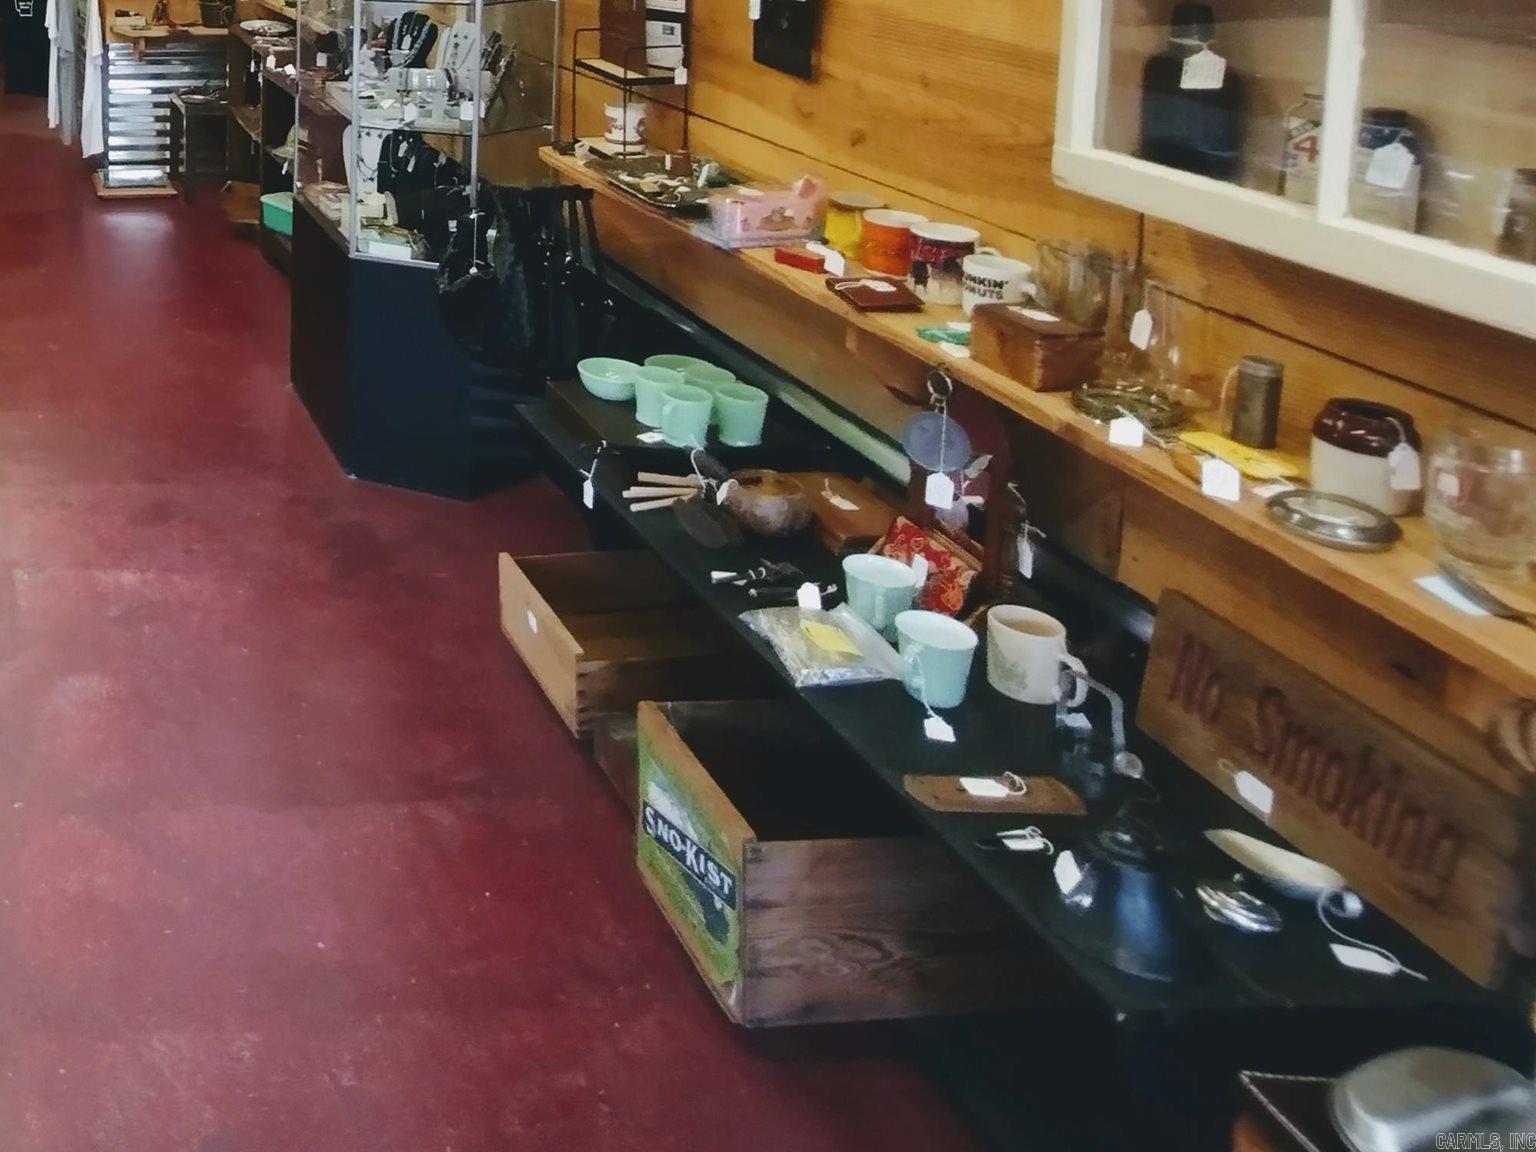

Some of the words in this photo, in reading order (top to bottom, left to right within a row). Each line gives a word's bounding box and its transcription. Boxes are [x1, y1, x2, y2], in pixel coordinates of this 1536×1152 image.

[963, 285, 1005, 301] NUTS
[964, 273, 1009, 290] NKIN'
[1166, 633, 1222, 724] No
[1248, 685, 1464, 896] Smoking
[644, 805, 734, 895] SNO-KIST
